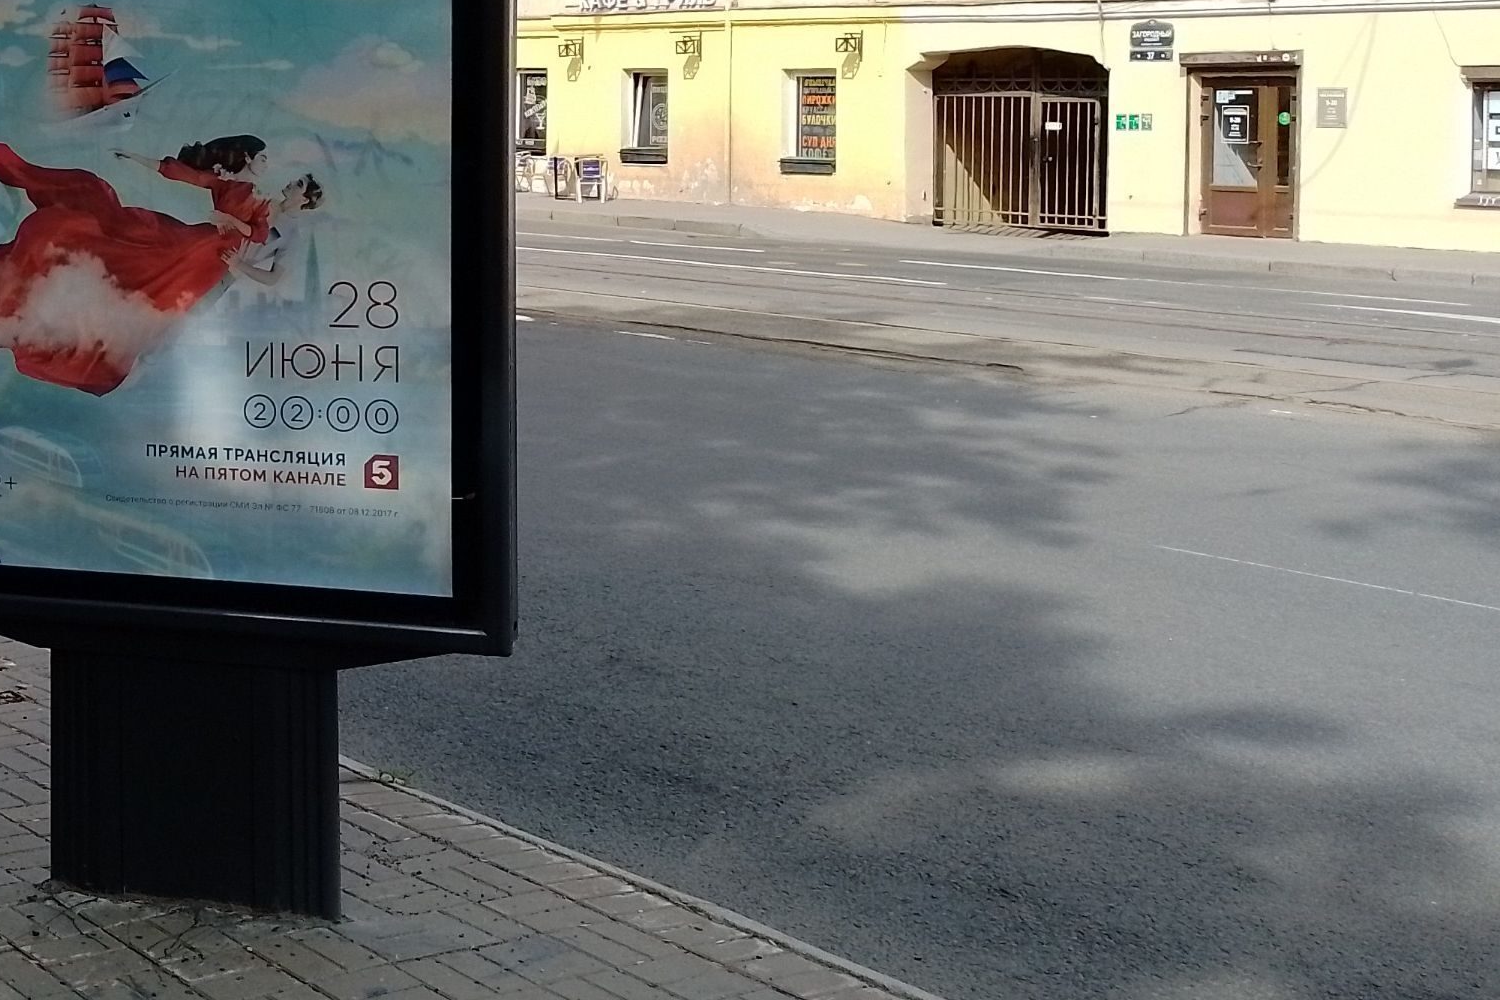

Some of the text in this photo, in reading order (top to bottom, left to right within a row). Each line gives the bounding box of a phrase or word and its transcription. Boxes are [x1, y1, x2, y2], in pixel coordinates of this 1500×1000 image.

[328, 281, 399, 329] 28
[246, 341, 400, 383] ИЮНЯ
[243, 394, 399, 434] 22:00
[145, 443, 346, 467] ПРЯМАЯ ТРАНСЛЯЦИЯ
[175, 466, 346, 487] НА ПЯТОМ КАНАЛЕ
[371, 460, 393, 485] 5
